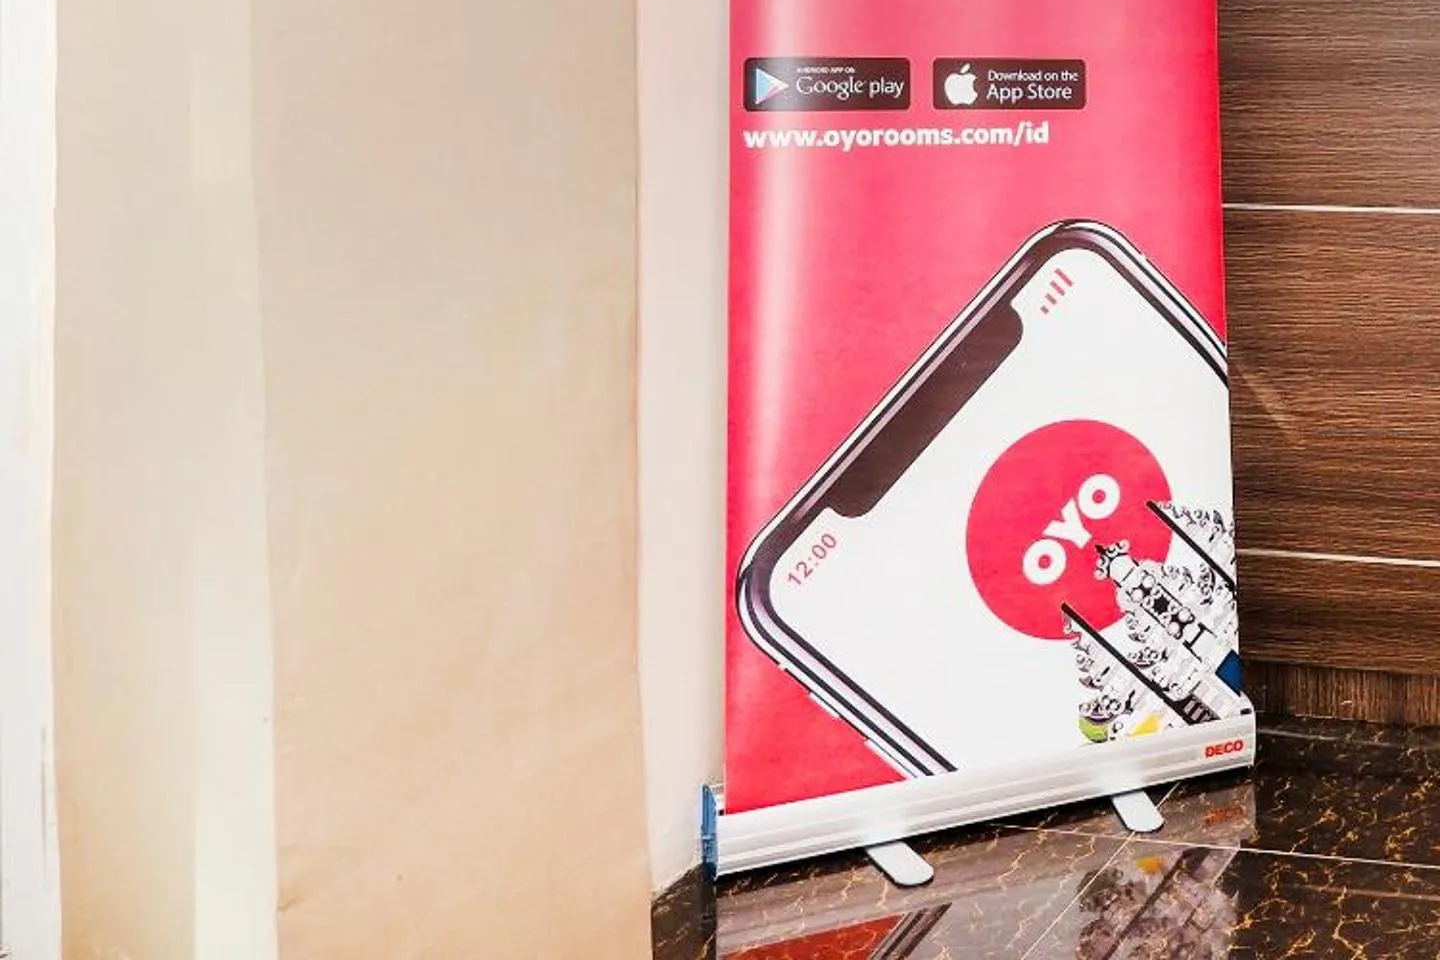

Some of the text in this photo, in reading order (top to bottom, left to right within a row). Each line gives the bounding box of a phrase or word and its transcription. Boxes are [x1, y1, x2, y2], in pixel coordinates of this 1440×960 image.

[796, 75, 905, 101] Google play
[987, 69, 1079, 82] Download on the
[986, 83, 1073, 104] App Store
[743, 120, 1050, 152] www.oyorooms.com/id
[1022, 472, 1121, 586] OYO
[787, 533, 837, 586] 12:00
[1205, 739, 1244, 758] DECO
